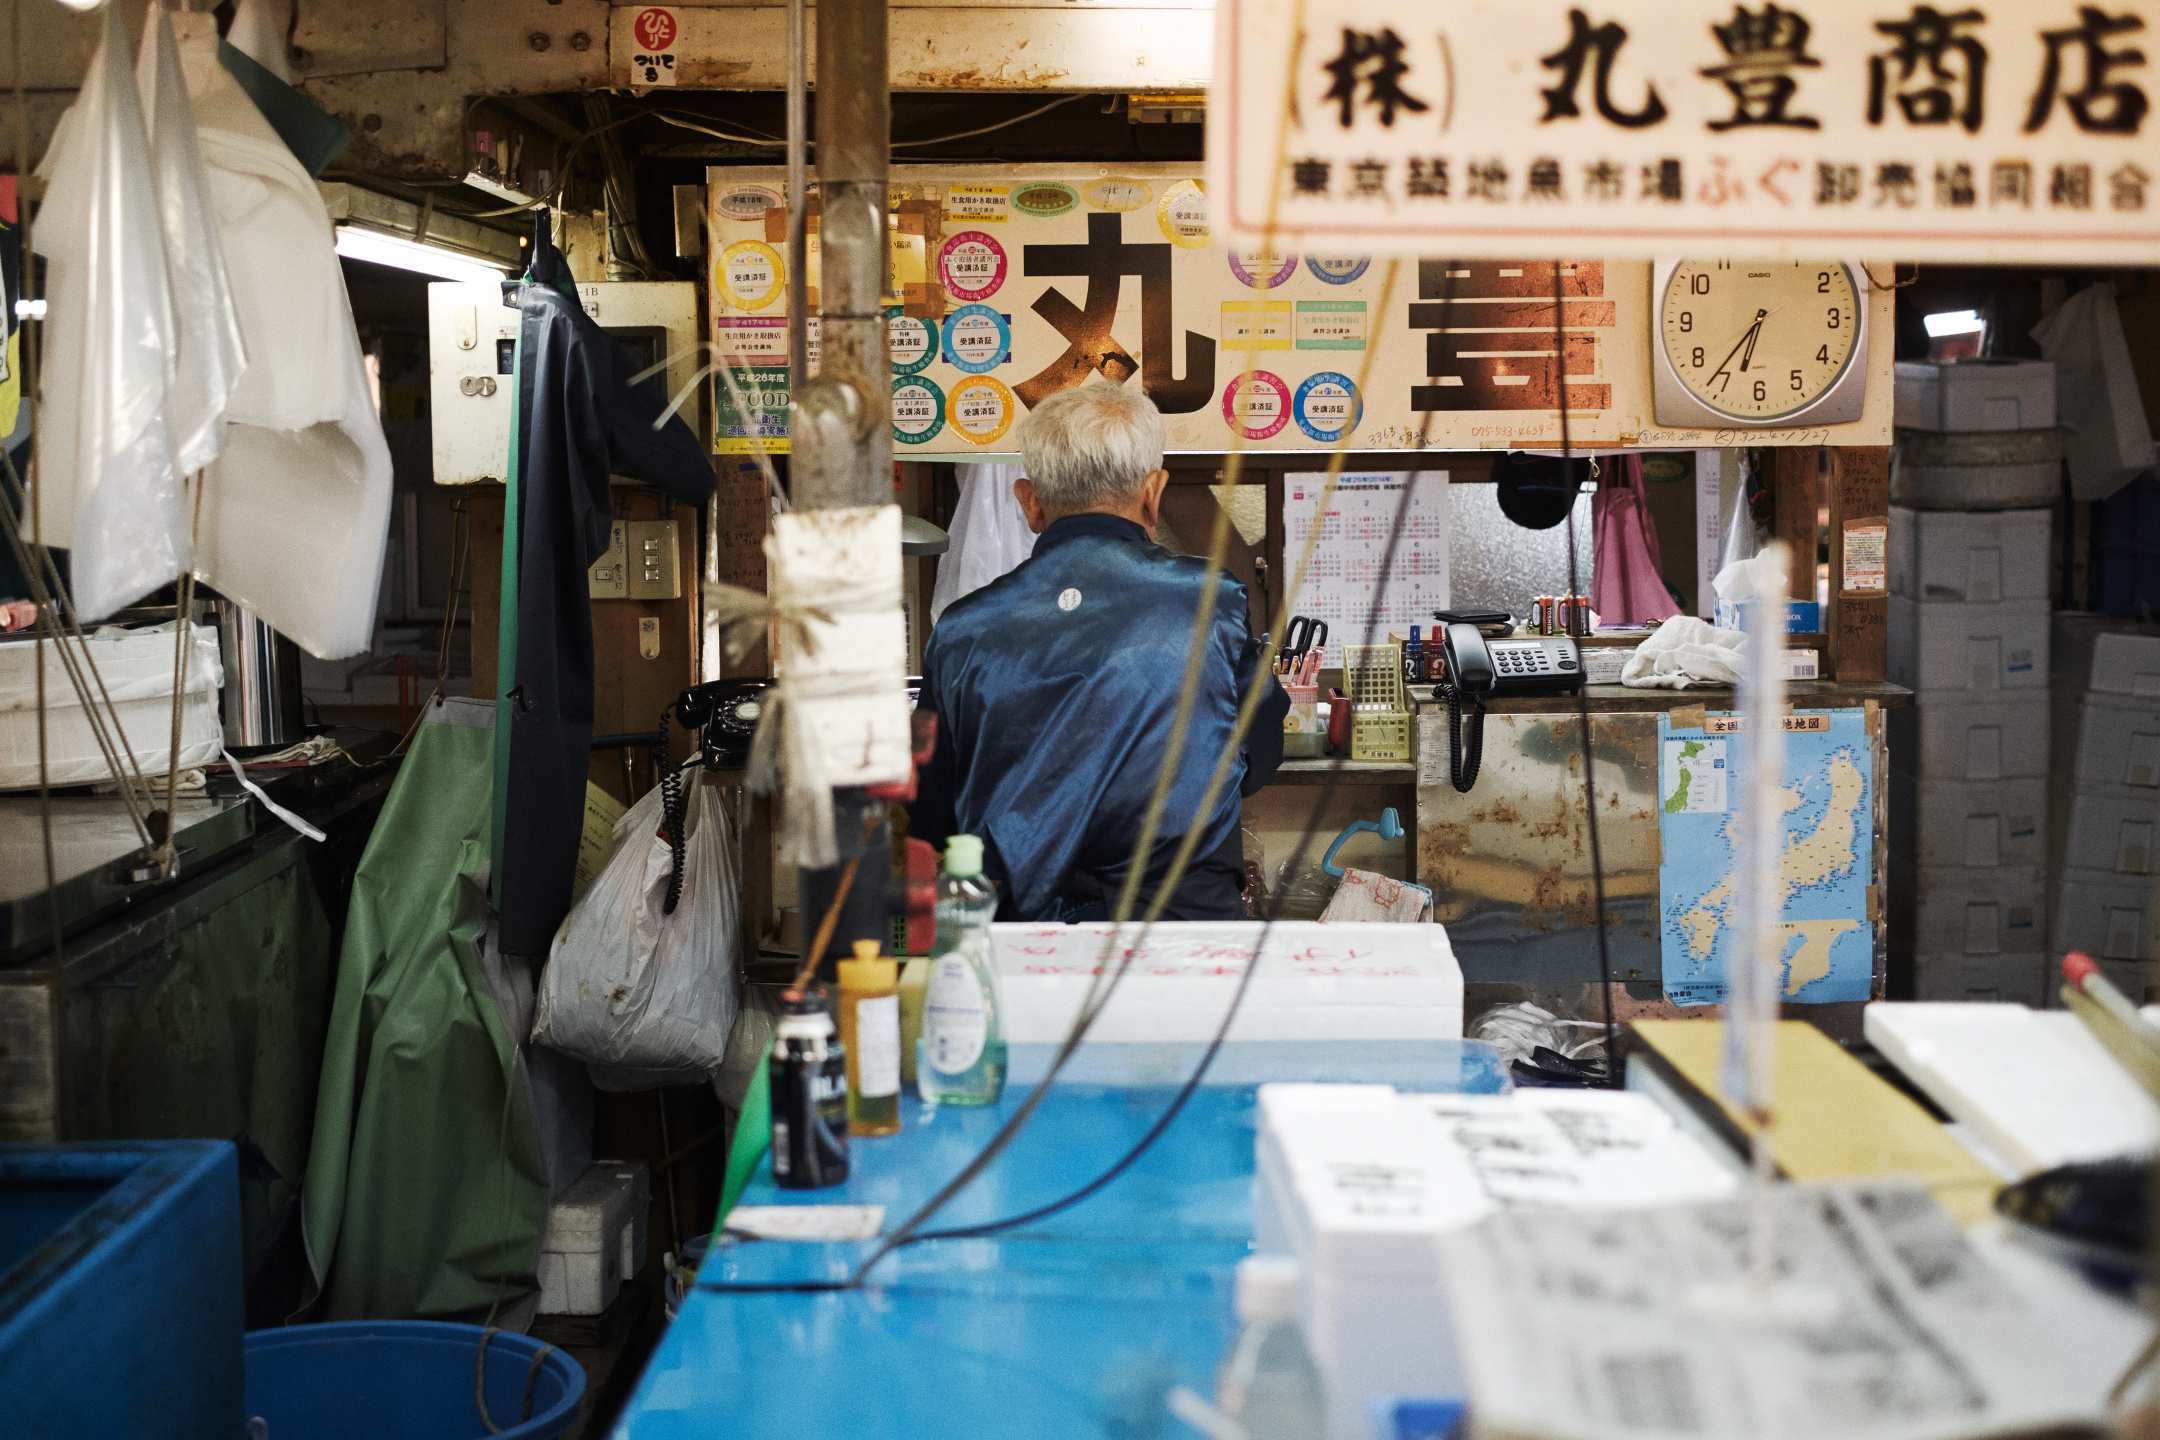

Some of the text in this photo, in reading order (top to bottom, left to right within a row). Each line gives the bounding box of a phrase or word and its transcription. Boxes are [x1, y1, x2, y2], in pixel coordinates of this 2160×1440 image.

[1691, 274, 1710, 295] 10
[1817, 272, 1830, 293] 2
[1680, 312, 1693, 333] 9
[1827, 308, 1840, 329] 3
[1692, 347, 1704, 368] 8
[1816, 344, 1829, 365] 4
[1718, 372, 1730, 393] 7
[1790, 369, 1803, 390] 5
[1753, 380, 1766, 401] 6
